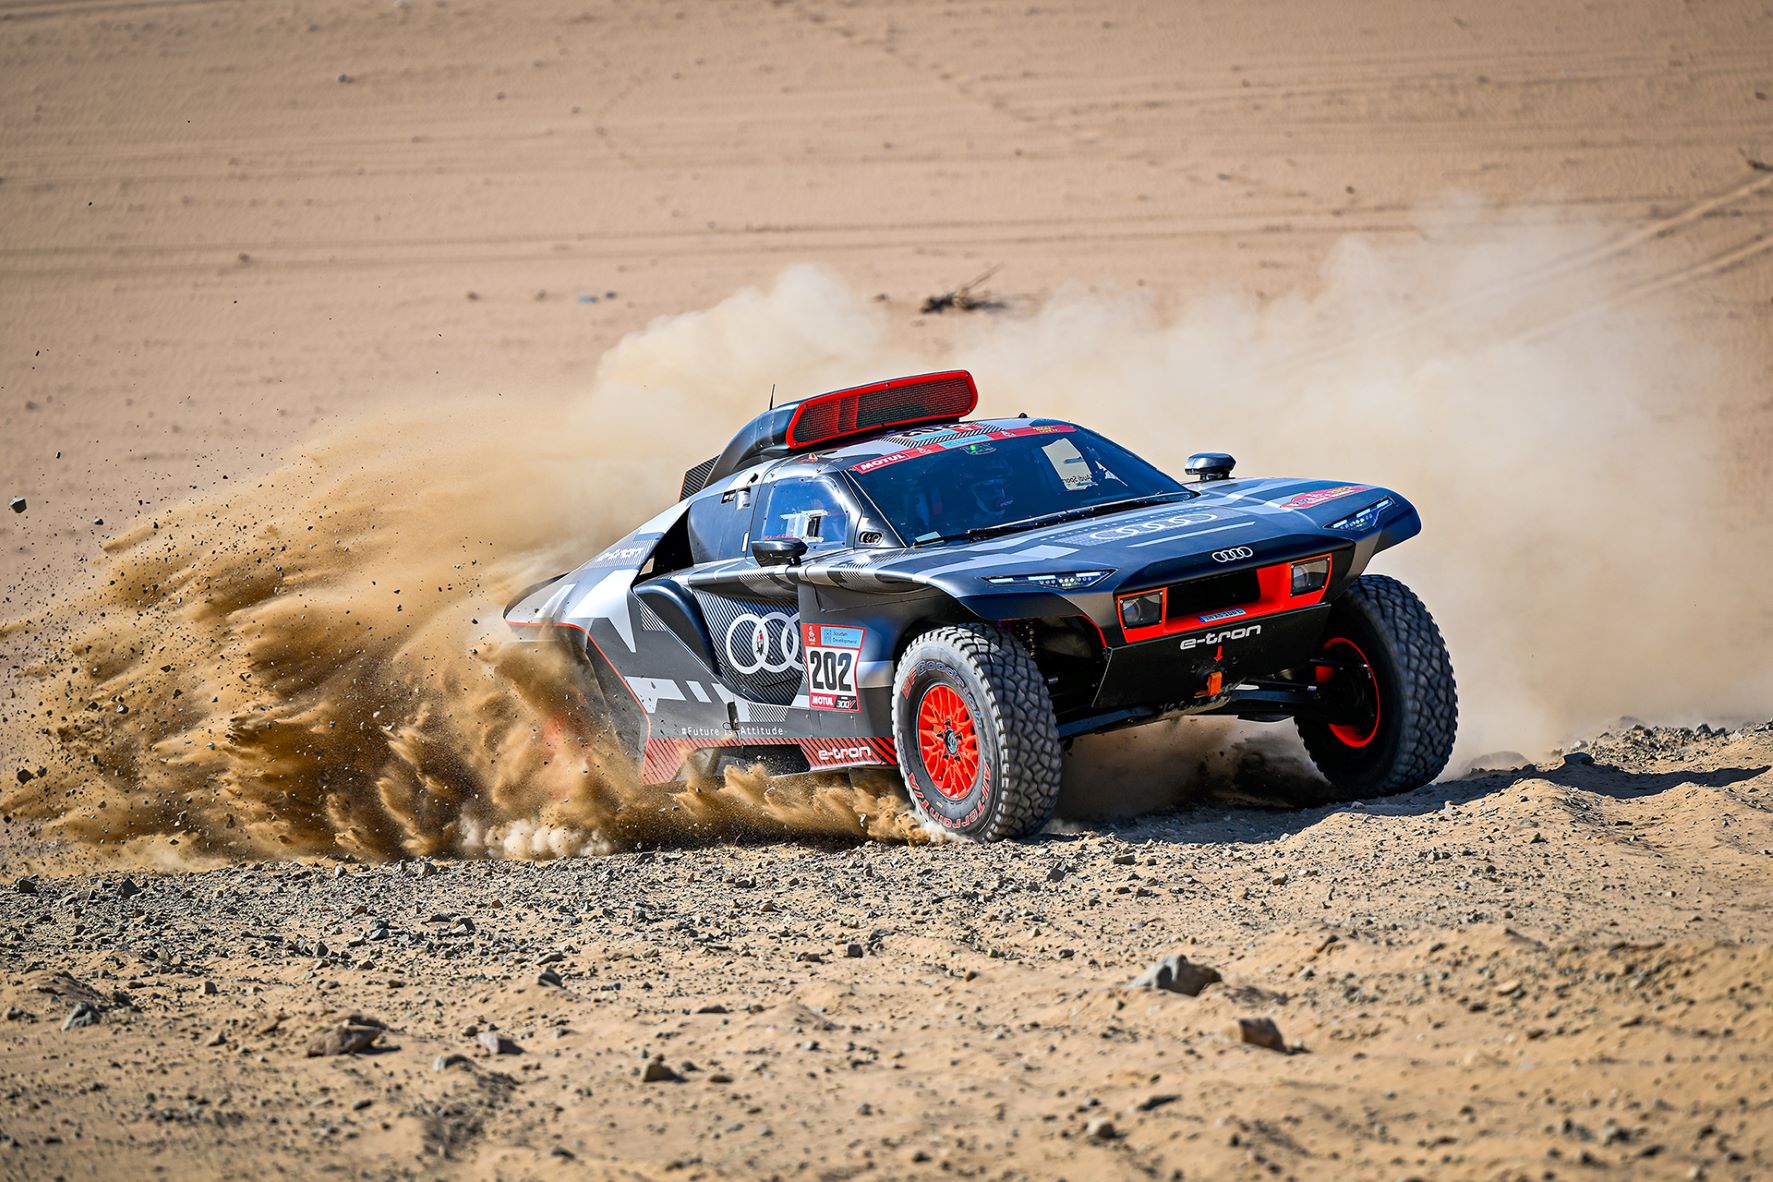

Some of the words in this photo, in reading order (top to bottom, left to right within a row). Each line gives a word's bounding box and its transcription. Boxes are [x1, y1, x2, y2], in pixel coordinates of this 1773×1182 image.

[860, 454, 906, 470] MOTUL
[1180, 624, 1262, 651] e-tron
[810, 650, 852, 691] 202
[812, 695, 834, 706] MOTUL
[681, 726, 720, 736] #Future
[740, 726, 784, 736] Attitude
[818, 746, 872, 760] e-tron
